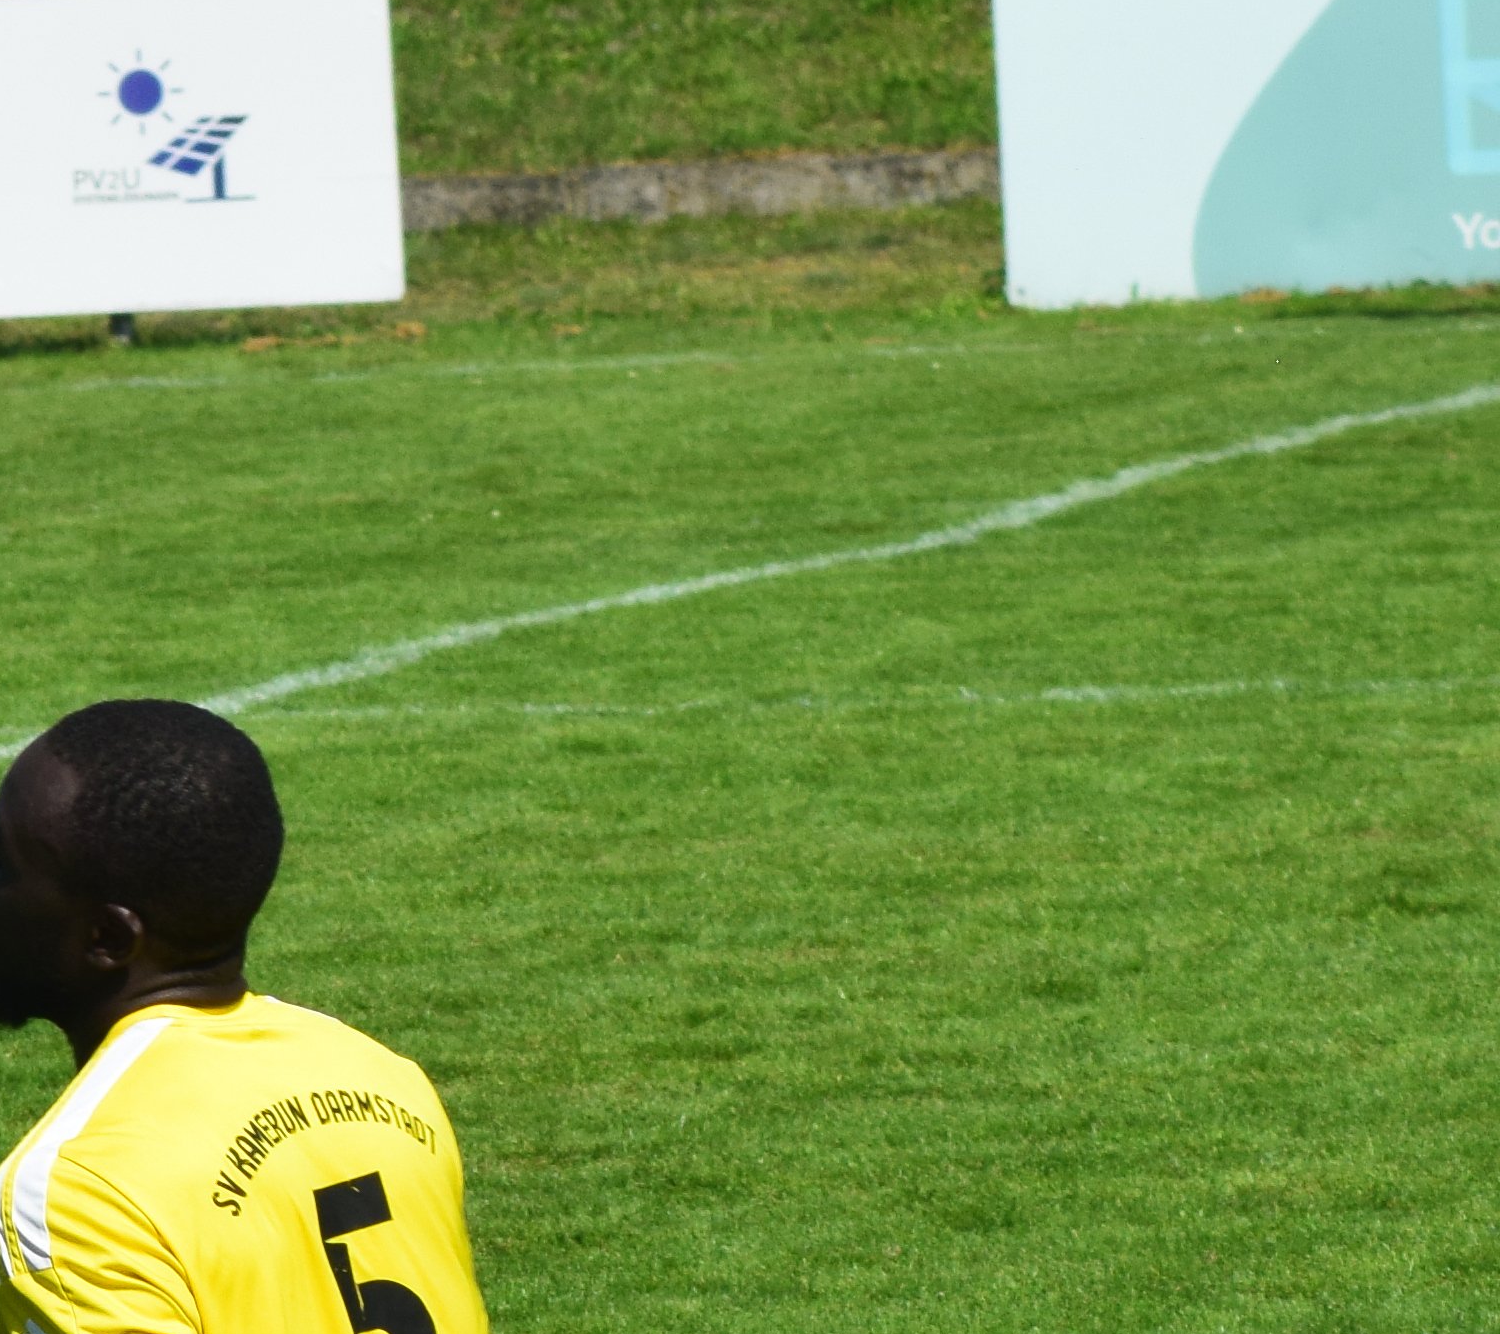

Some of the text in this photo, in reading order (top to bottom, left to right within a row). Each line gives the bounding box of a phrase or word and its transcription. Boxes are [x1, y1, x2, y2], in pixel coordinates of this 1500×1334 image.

[211, 1089, 437, 1217] SV KAMERUN DARMSTADT
